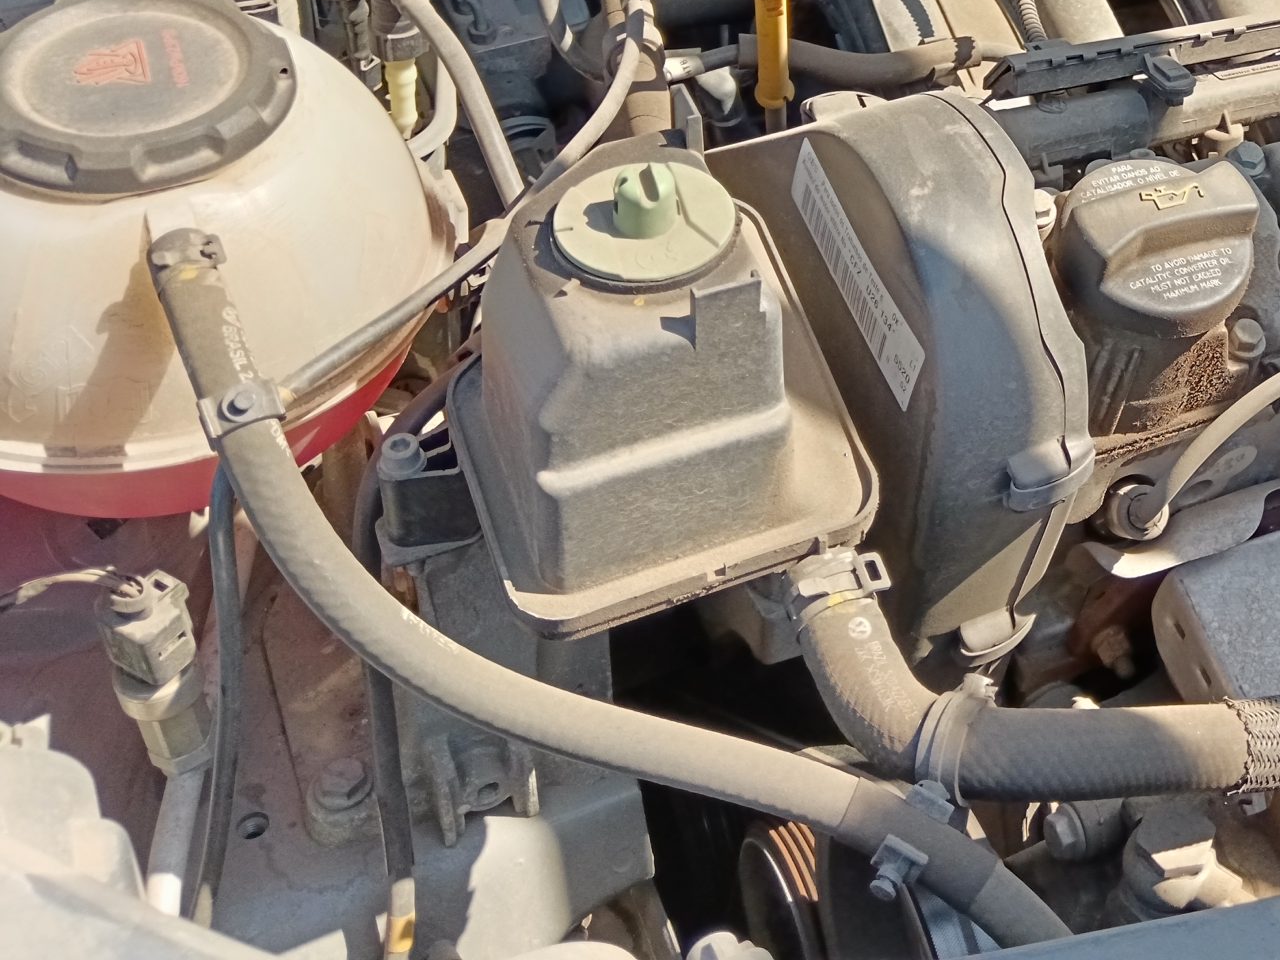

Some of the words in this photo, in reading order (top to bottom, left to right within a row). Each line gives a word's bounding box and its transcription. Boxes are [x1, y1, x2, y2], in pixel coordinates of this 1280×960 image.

[1112, 164, 1133, 173] PARA
[1092, 175, 1120, 187] EVITAR
[1151, 264, 1162, 272] TO
[1164, 258, 1186, 269] AVOID
[1188, 250, 1219, 262] DAMAGE
[1174, 260, 1218, 276] CONVERTER
[1151, 281, 1172, 293] MUST
[1174, 276, 1190, 286] NOT
[1193, 268, 1221, 281] EXCEED
[1163, 285, 1199, 299] MAXIMUM
[1200, 279, 1222, 289] MARK
[222, 324, 247, 371] BRASIL
